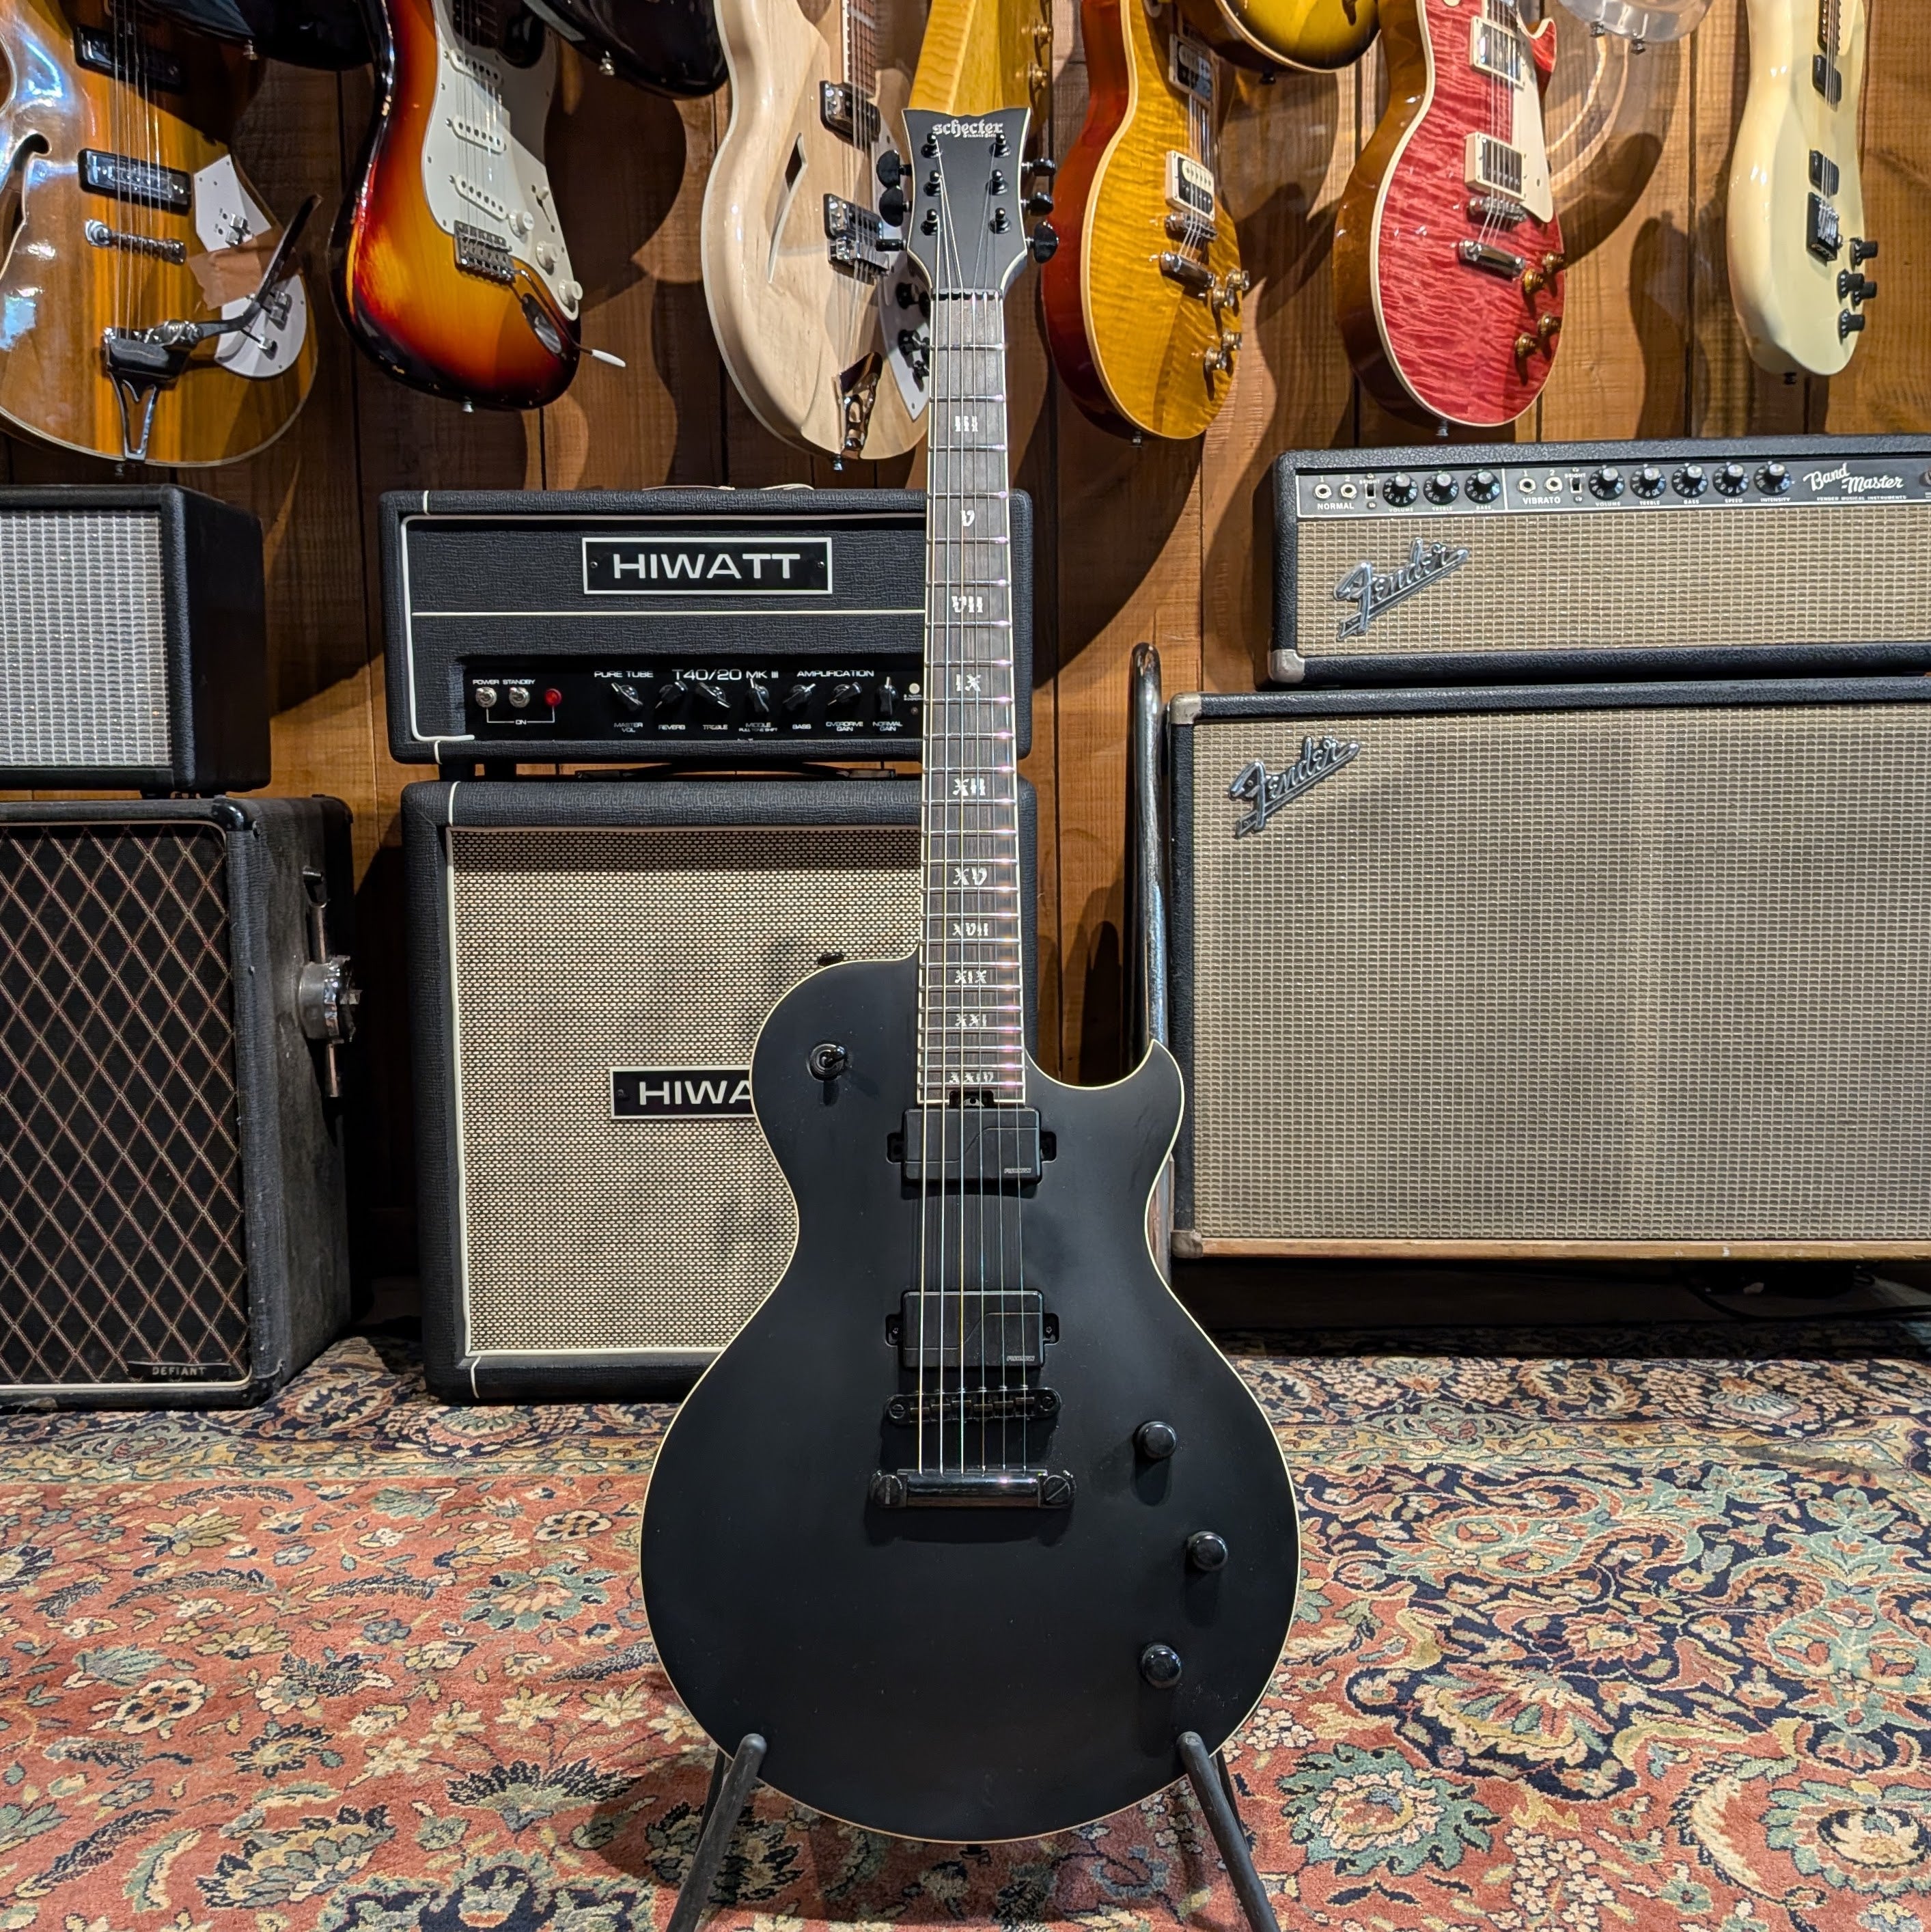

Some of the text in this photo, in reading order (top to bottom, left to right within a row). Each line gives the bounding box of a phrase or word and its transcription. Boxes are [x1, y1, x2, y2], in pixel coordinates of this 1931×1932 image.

[932, 119, 1003, 137] schecter
[1803, 463, 1904, 493] Band Master
[1523, 497, 1561, 505] VIBRATO
[613, 553, 801, 579] HIWATT
[1333, 536, 1469, 641] Fender
[951, 596, 983, 613] VII
[672, 669, 742, 680] T40/20
[746, 670, 767, 679] MK
[796, 670, 874, 678] AMPLIFICATION
[956, 674, 981, 691] IX
[953, 778, 986, 796] XII
[1228, 735, 1361, 839] Fender
[953, 867, 988, 885] XV
[952, 923, 988, 936] XVII
[955, 970, 987, 984] XIX
[955, 1014, 987, 1026] XXI
[639, 1080, 751, 1105] HIWA
[152, 1367, 206, 1375] DEFIANT
